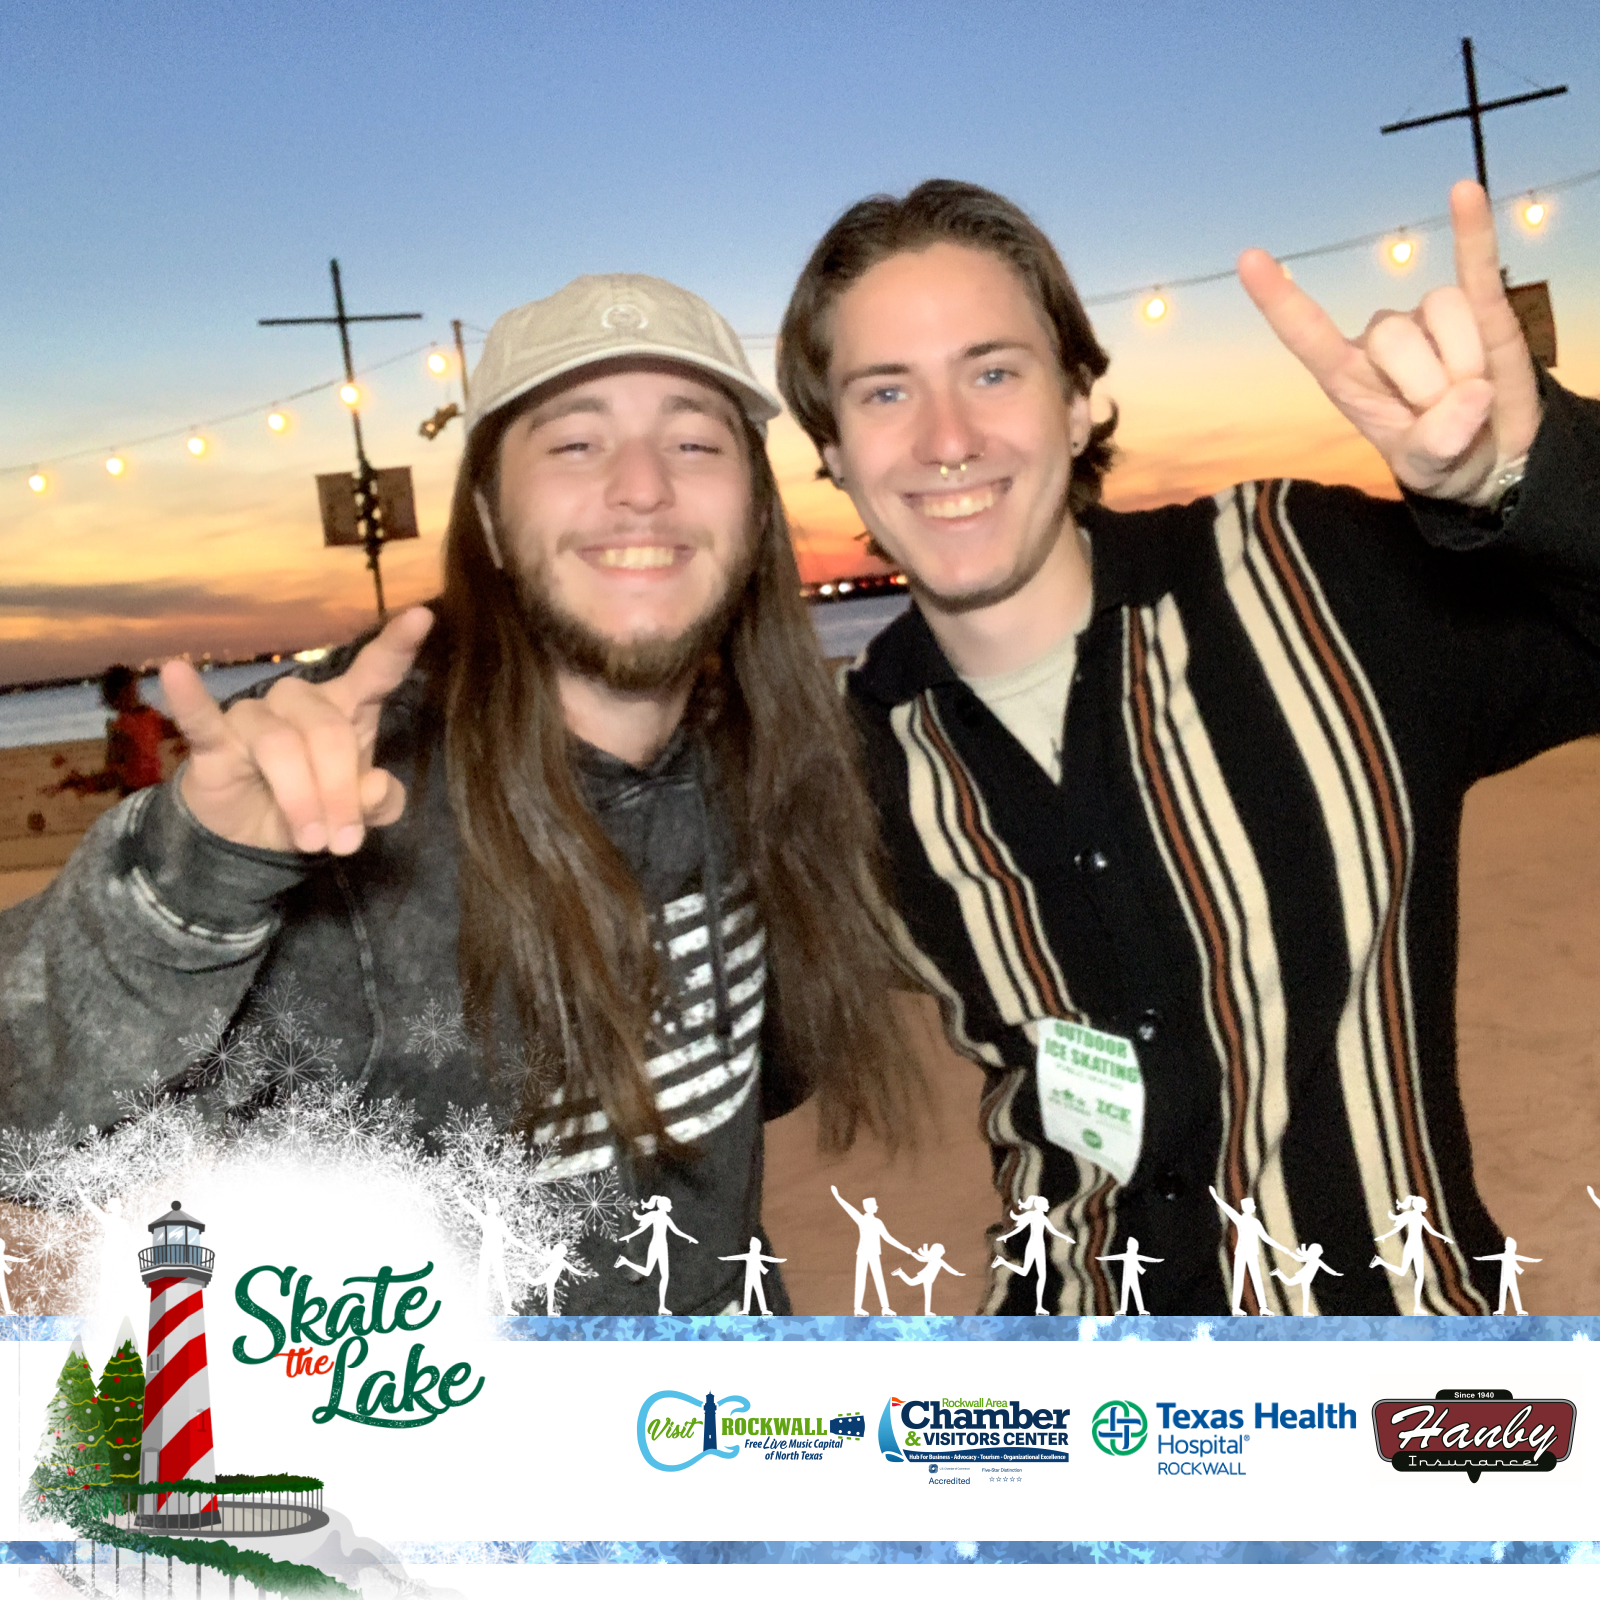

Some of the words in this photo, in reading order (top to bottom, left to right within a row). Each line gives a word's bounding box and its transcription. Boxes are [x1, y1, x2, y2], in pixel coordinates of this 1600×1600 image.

[1054, 1021, 1128, 1059] OUTDOOR
[1044, 1037, 1067, 1061] ICE
[1071, 1048, 1140, 1083] SKATING
[1096, 1098, 1131, 1122] ICE
